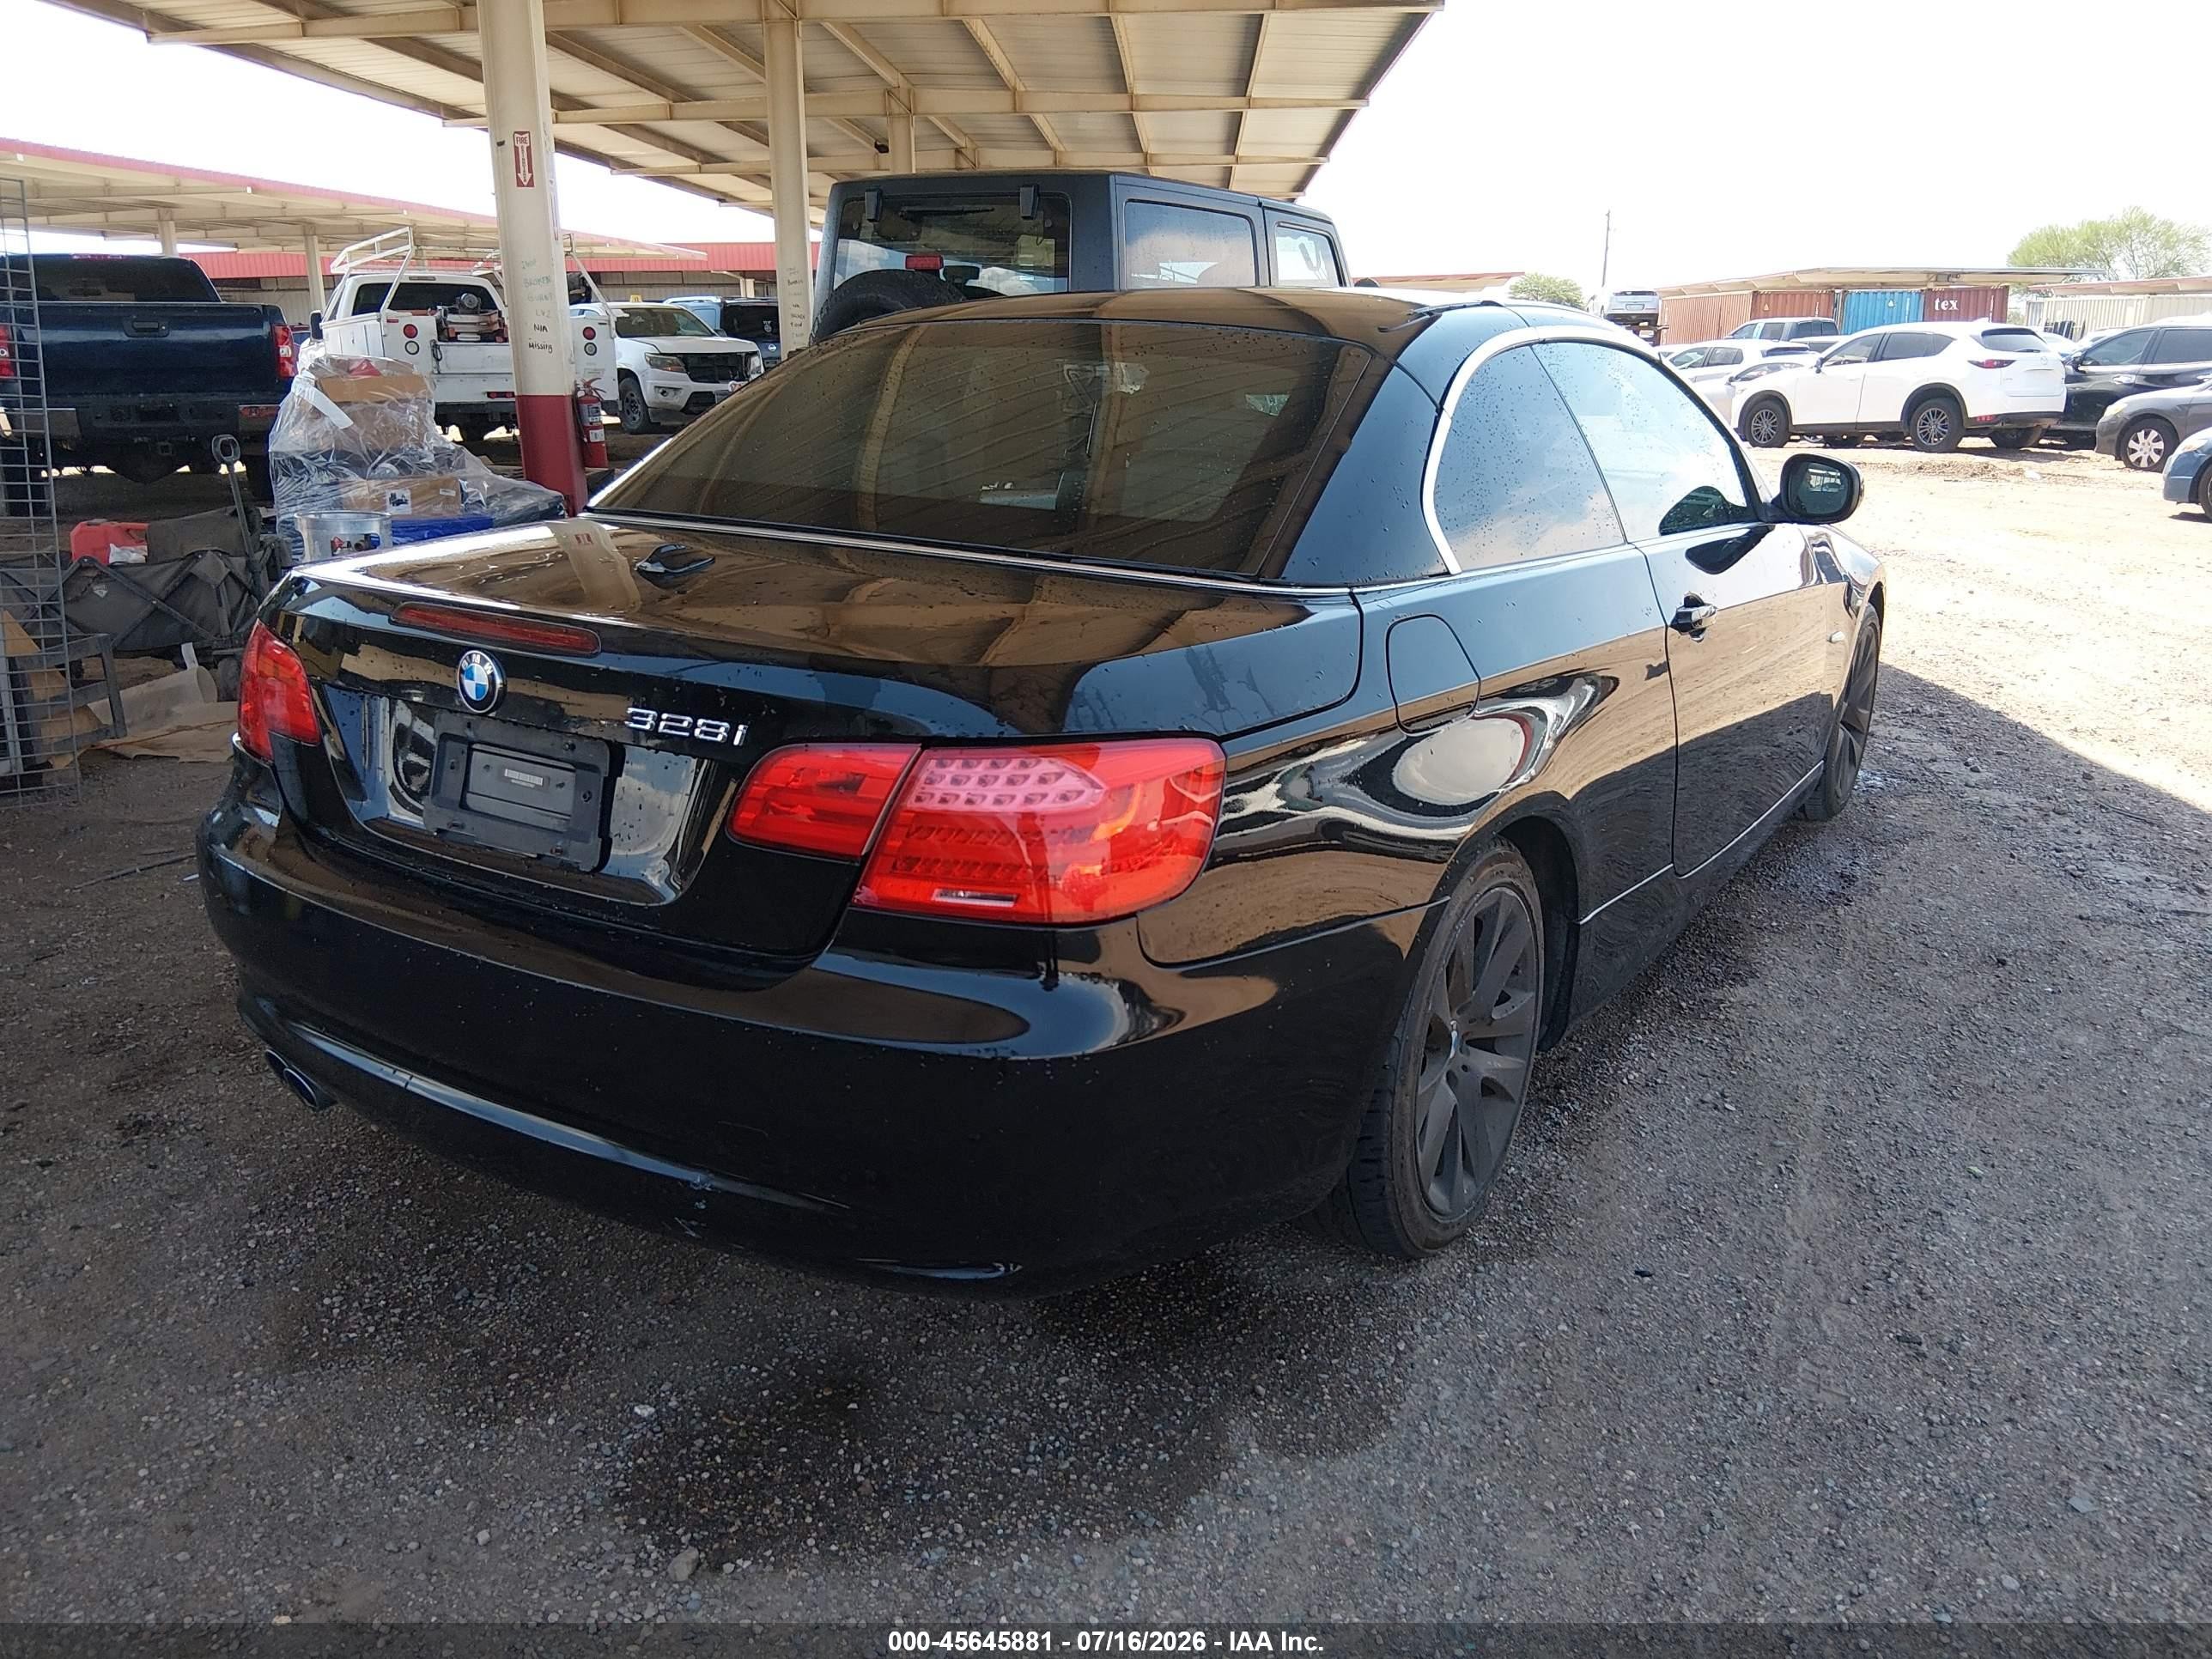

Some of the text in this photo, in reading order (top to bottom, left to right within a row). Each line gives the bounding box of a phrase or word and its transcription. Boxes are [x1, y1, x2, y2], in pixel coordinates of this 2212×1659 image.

[516, 137, 529, 145] FIRE
[1935, 297, 1959, 311] tex
[461, 653, 494, 675] BMW
[624, 707, 749, 746] 328i
